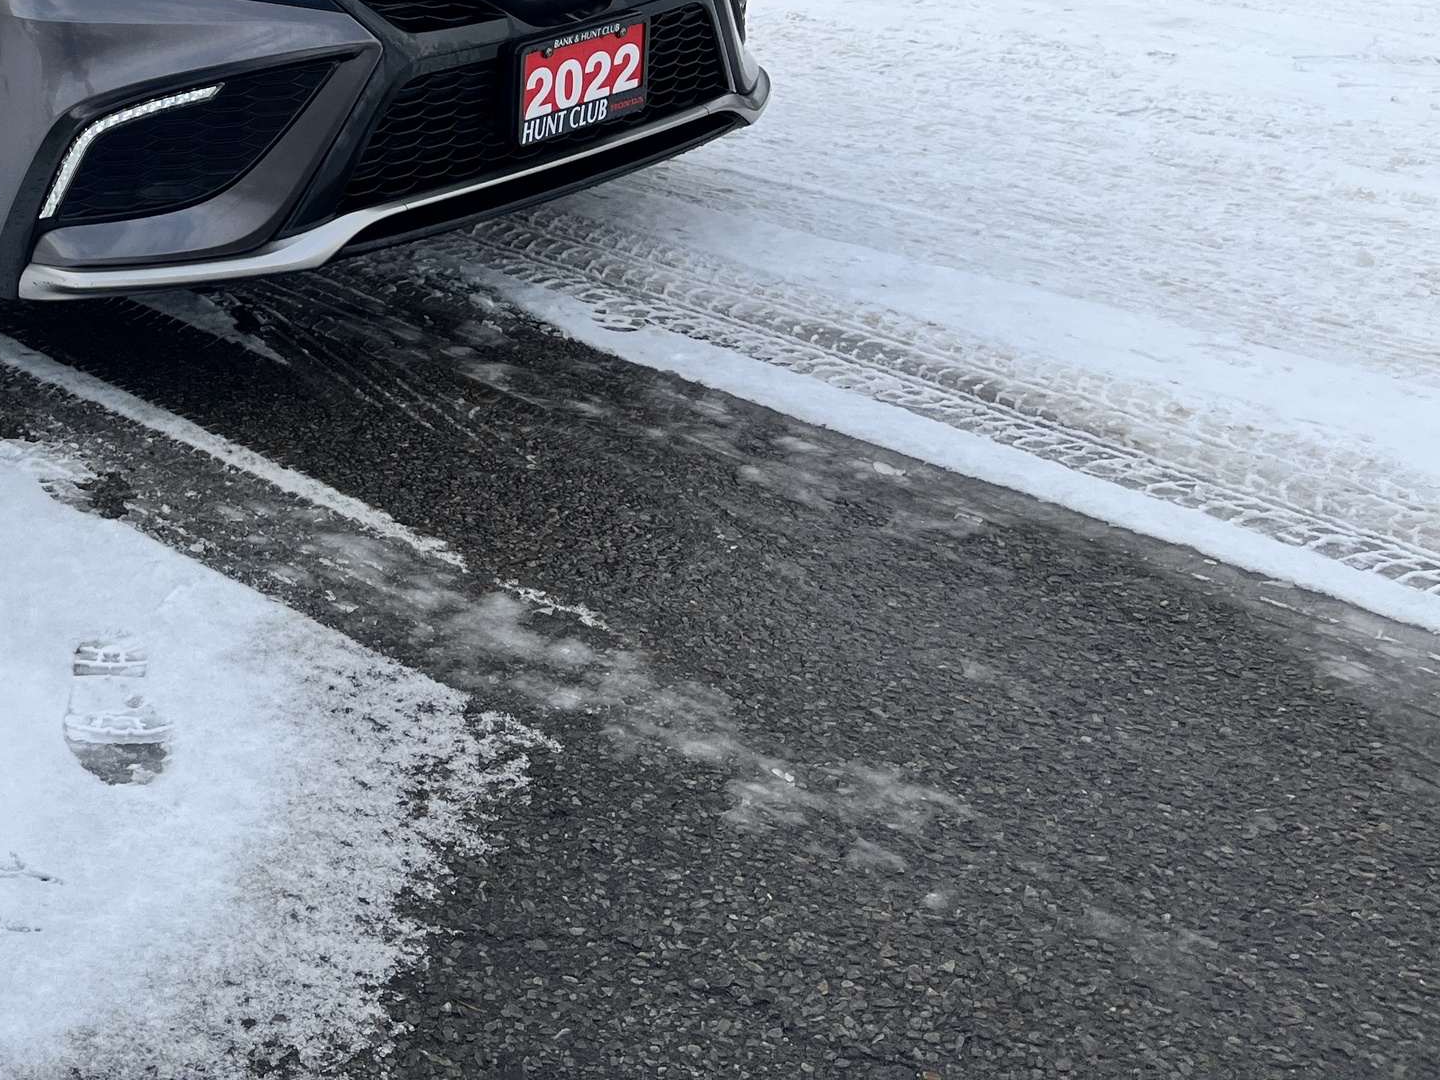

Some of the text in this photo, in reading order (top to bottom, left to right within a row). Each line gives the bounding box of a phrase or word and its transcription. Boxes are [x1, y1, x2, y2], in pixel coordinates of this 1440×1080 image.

[554, 23, 620, 49] BANK & HUNT CLUB
[524, 43, 640, 121] 2022
[522, 110, 568, 145] HUNT
[569, 98, 609, 129] CLUB
